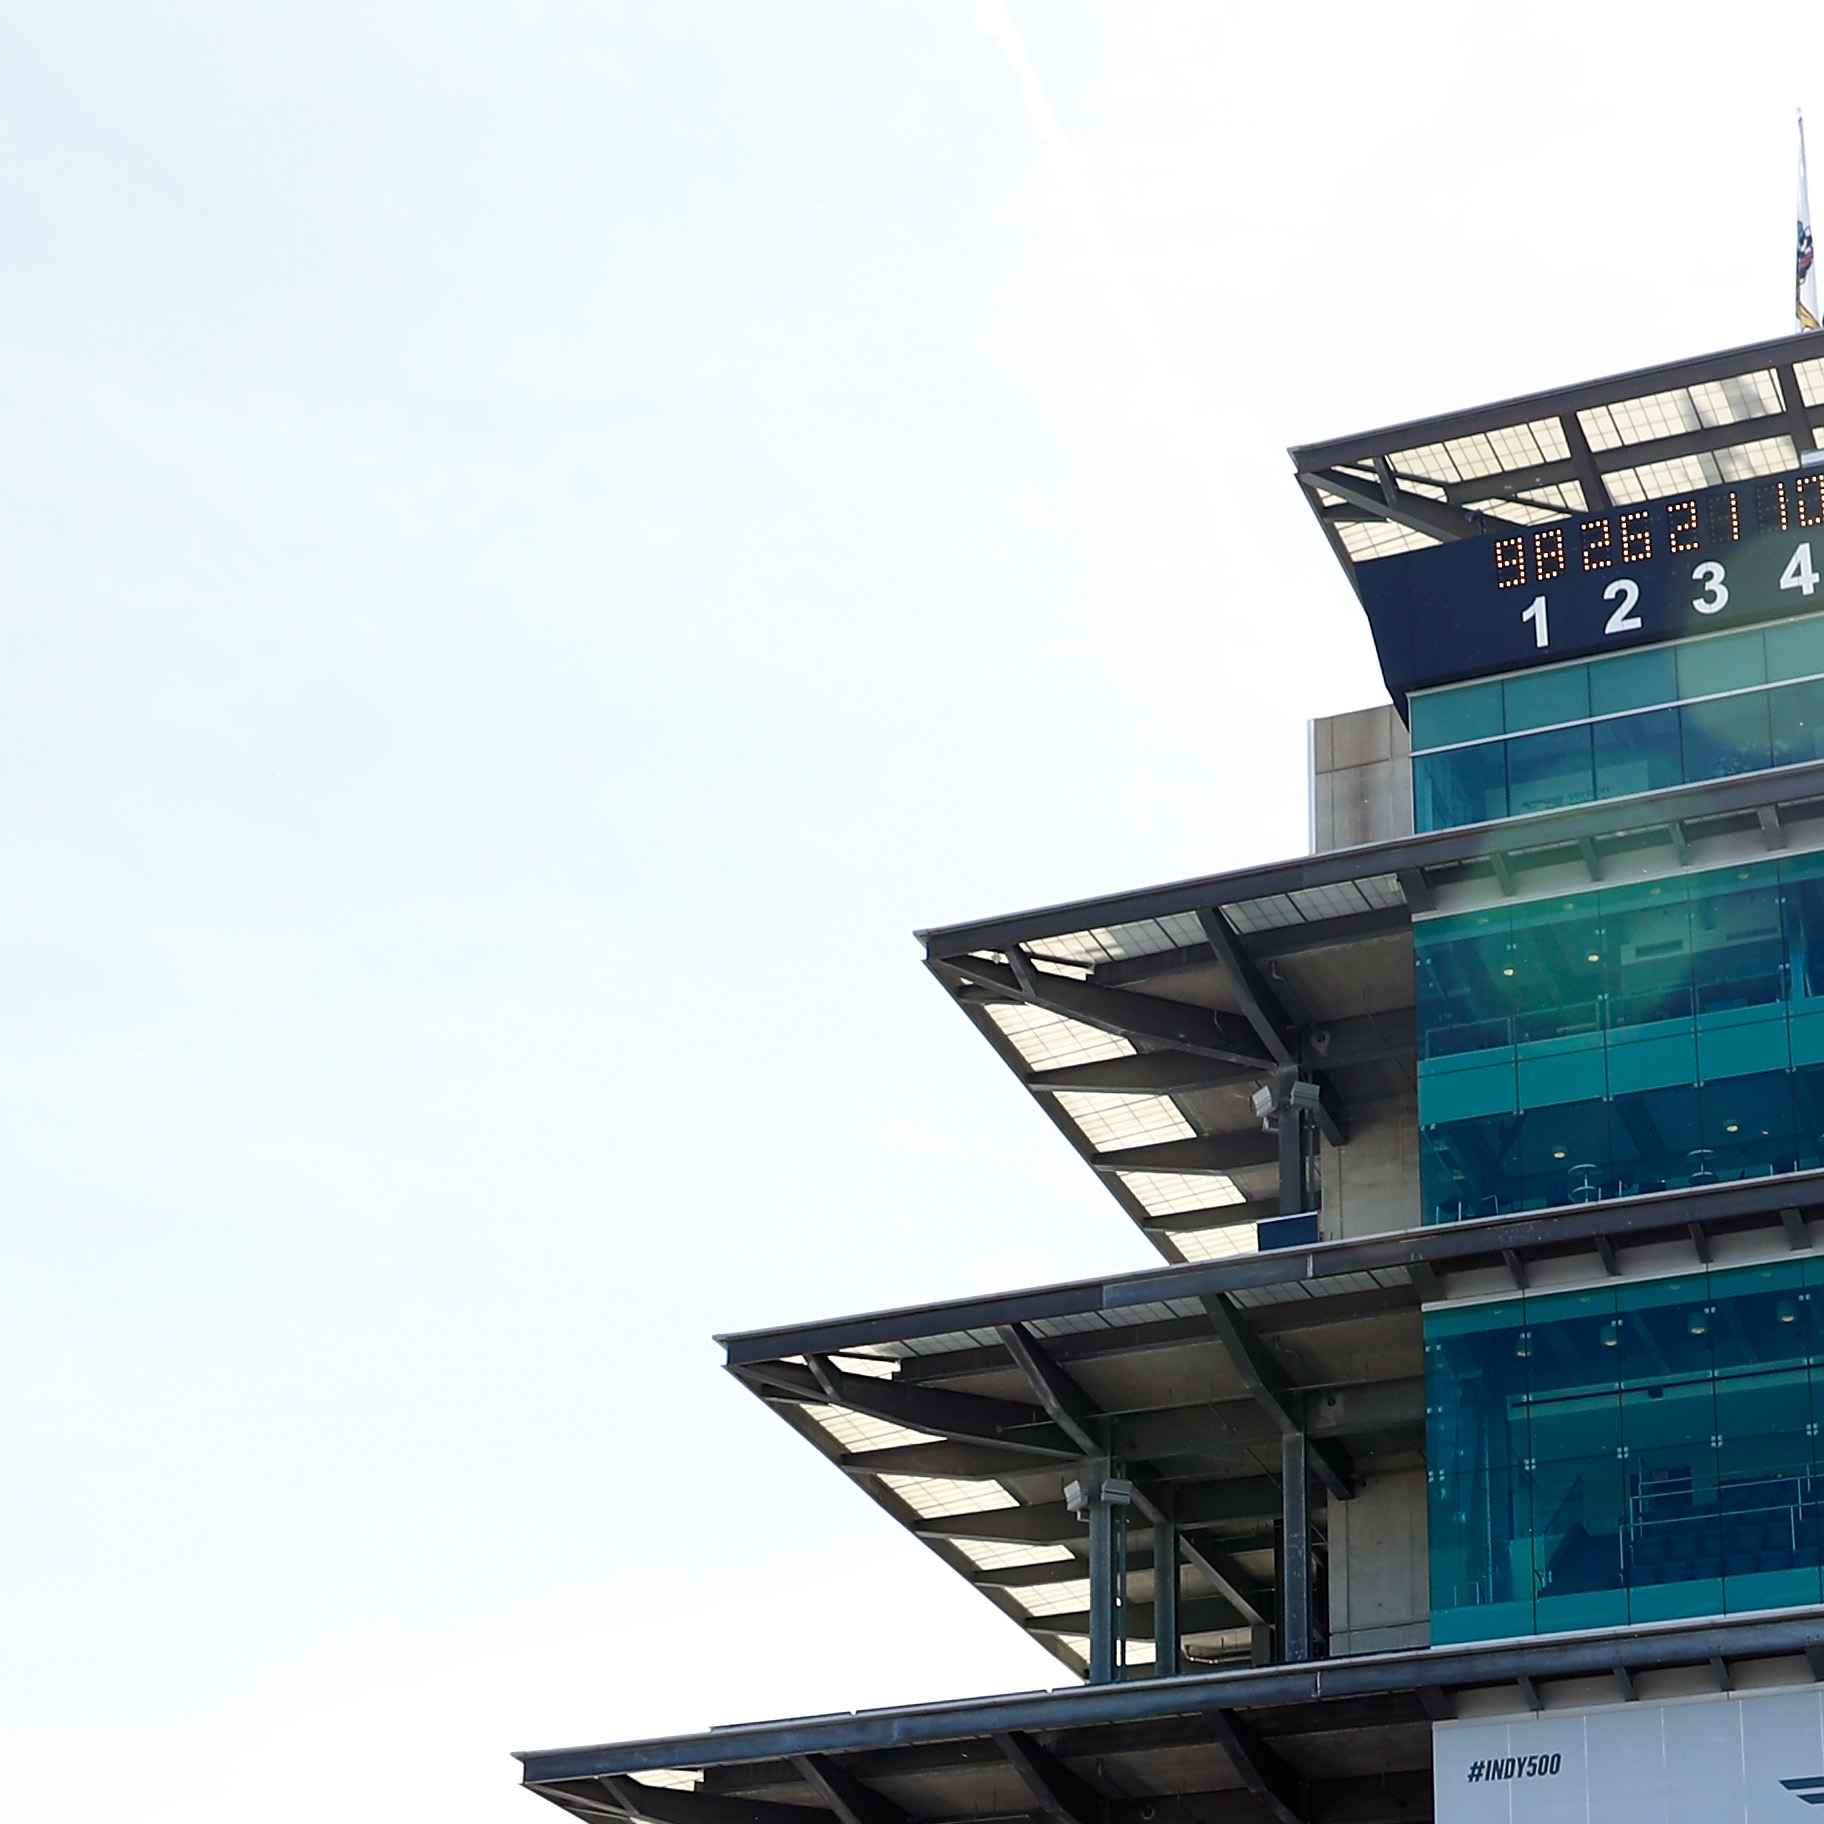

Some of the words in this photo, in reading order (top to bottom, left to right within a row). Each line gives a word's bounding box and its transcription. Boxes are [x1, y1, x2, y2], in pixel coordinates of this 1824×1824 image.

[1581, 510, 1654, 571] 26
[1666, 491, 1741, 553] 21
[1522, 596, 1550, 650] 1
[1603, 579, 1643, 635] 2
[1692, 561, 1730, 615] 3
[1780, 544, 1819, 597] 4
[1467, 1753, 1562, 1783] #INDY500
